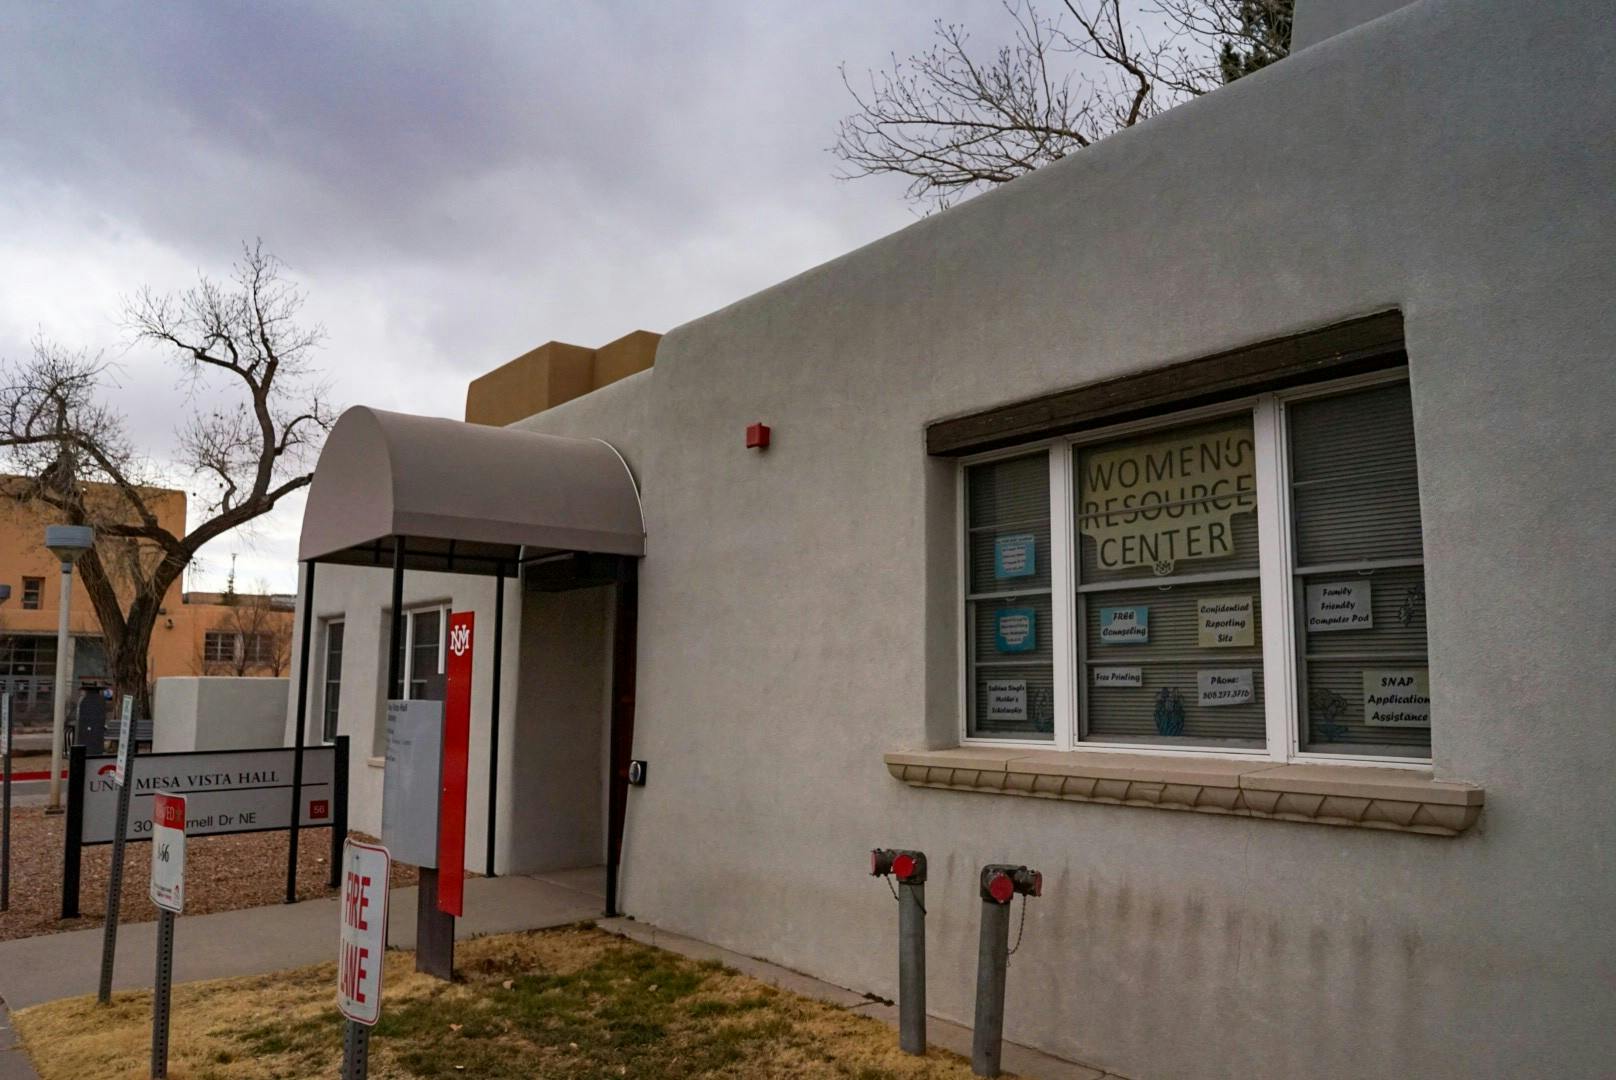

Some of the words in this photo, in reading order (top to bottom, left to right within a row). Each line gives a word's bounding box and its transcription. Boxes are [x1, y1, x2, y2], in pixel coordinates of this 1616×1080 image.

[1088, 437, 1253, 493] WOMEN'S
[1085, 474, 1253, 530] RESOURCE
[1100, 521, 1229, 567] CENTER
[1322, 586, 1352, 597] Family
[1200, 603, 1249, 614] Confidential
[1320, 601, 1355, 611] Friendly
[1113, 611, 1135, 622] FREE
[1309, 617, 1349, 626] Computer
[1351, 614, 1369, 623] Pod
[1205, 619, 1246, 629] Reporting
[1102, 626, 1146, 637] Counseling
[1218, 634, 1233, 643] Site
[1096, 672, 1110, 681] Free
[1110, 671, 1140, 682] Printing
[1210, 676, 1239, 686] Phone:
[1381, 676, 1414, 688] SNAP
[1368, 694, 1431, 706] Application
[1371, 711, 1429, 722] Assistance
[135, 777, 180, 791] MESA
[187, 773, 232, 787] VISTA
[238, 771, 280, 784] HALL
[219, 814, 234, 826] Dr
[239, 812, 257, 824] NE
[345, 871, 371, 931] FIRE
[340, 938, 369, 1004] LANE
